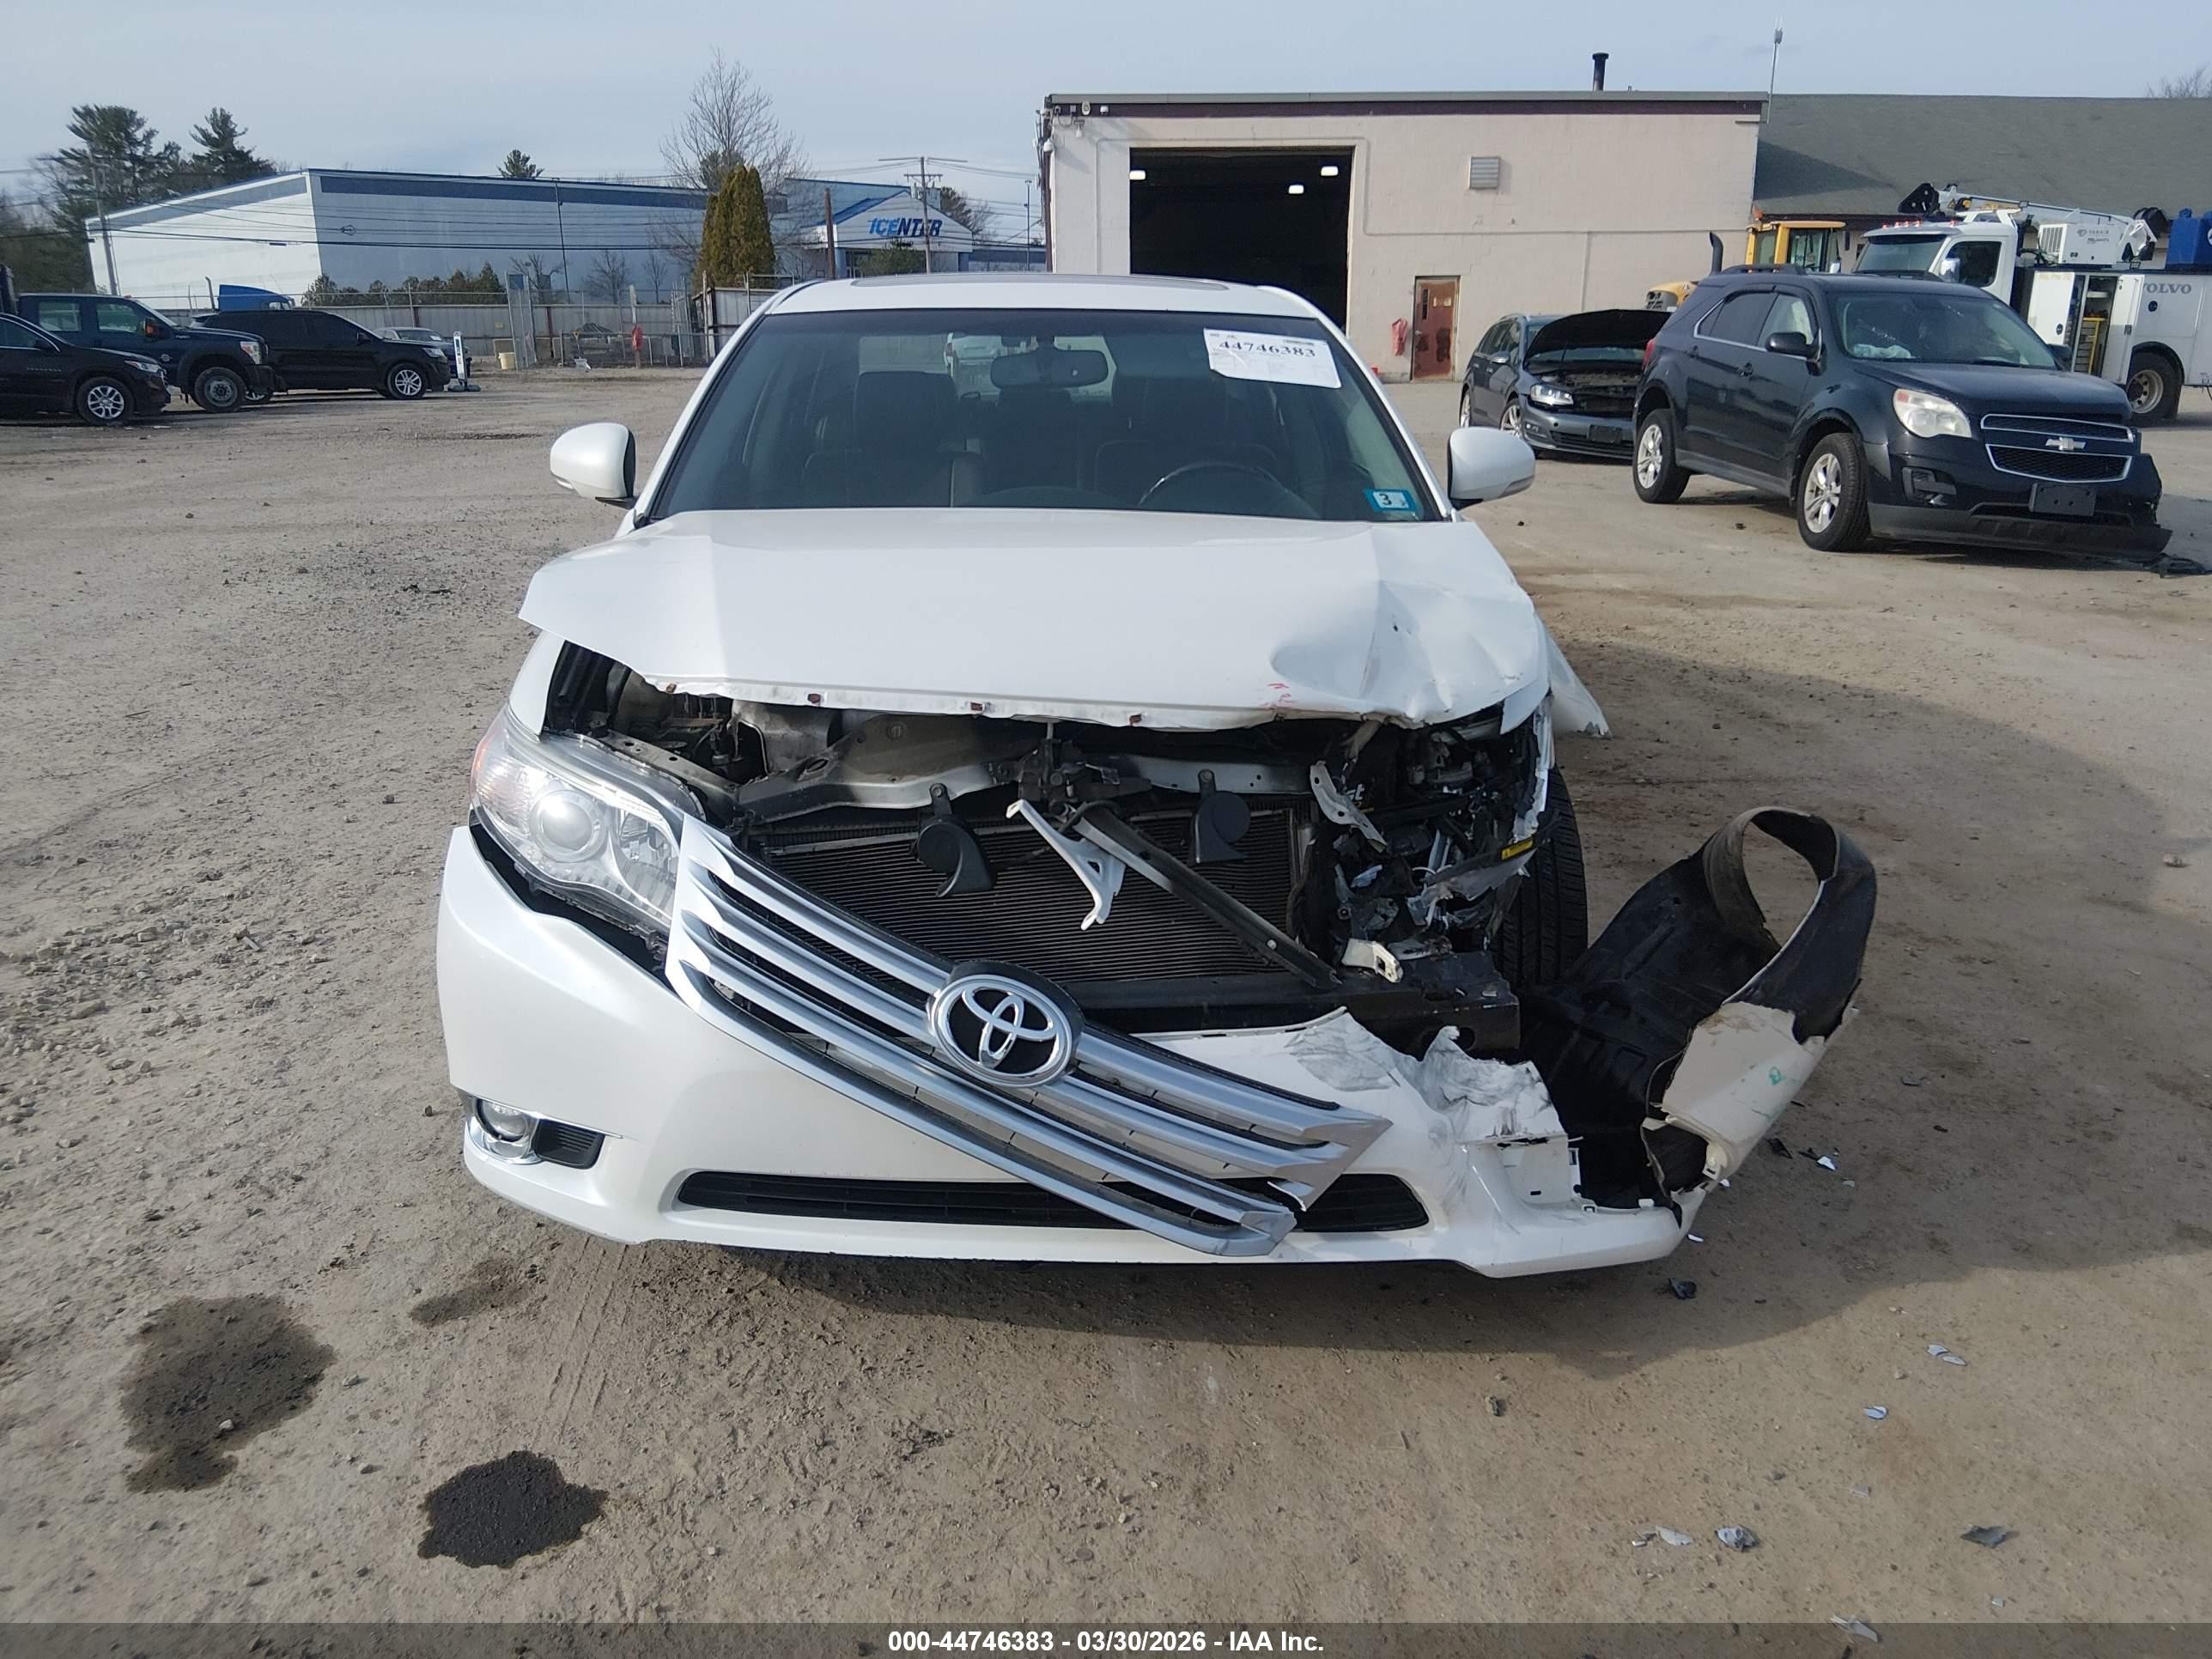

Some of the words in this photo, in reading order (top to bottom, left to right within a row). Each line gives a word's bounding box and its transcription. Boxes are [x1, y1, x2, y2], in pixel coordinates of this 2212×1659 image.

[868, 217, 943, 237] ICENTER
[1219, 340, 1316, 358] 44746383
[1378, 492, 1393, 507] 3
